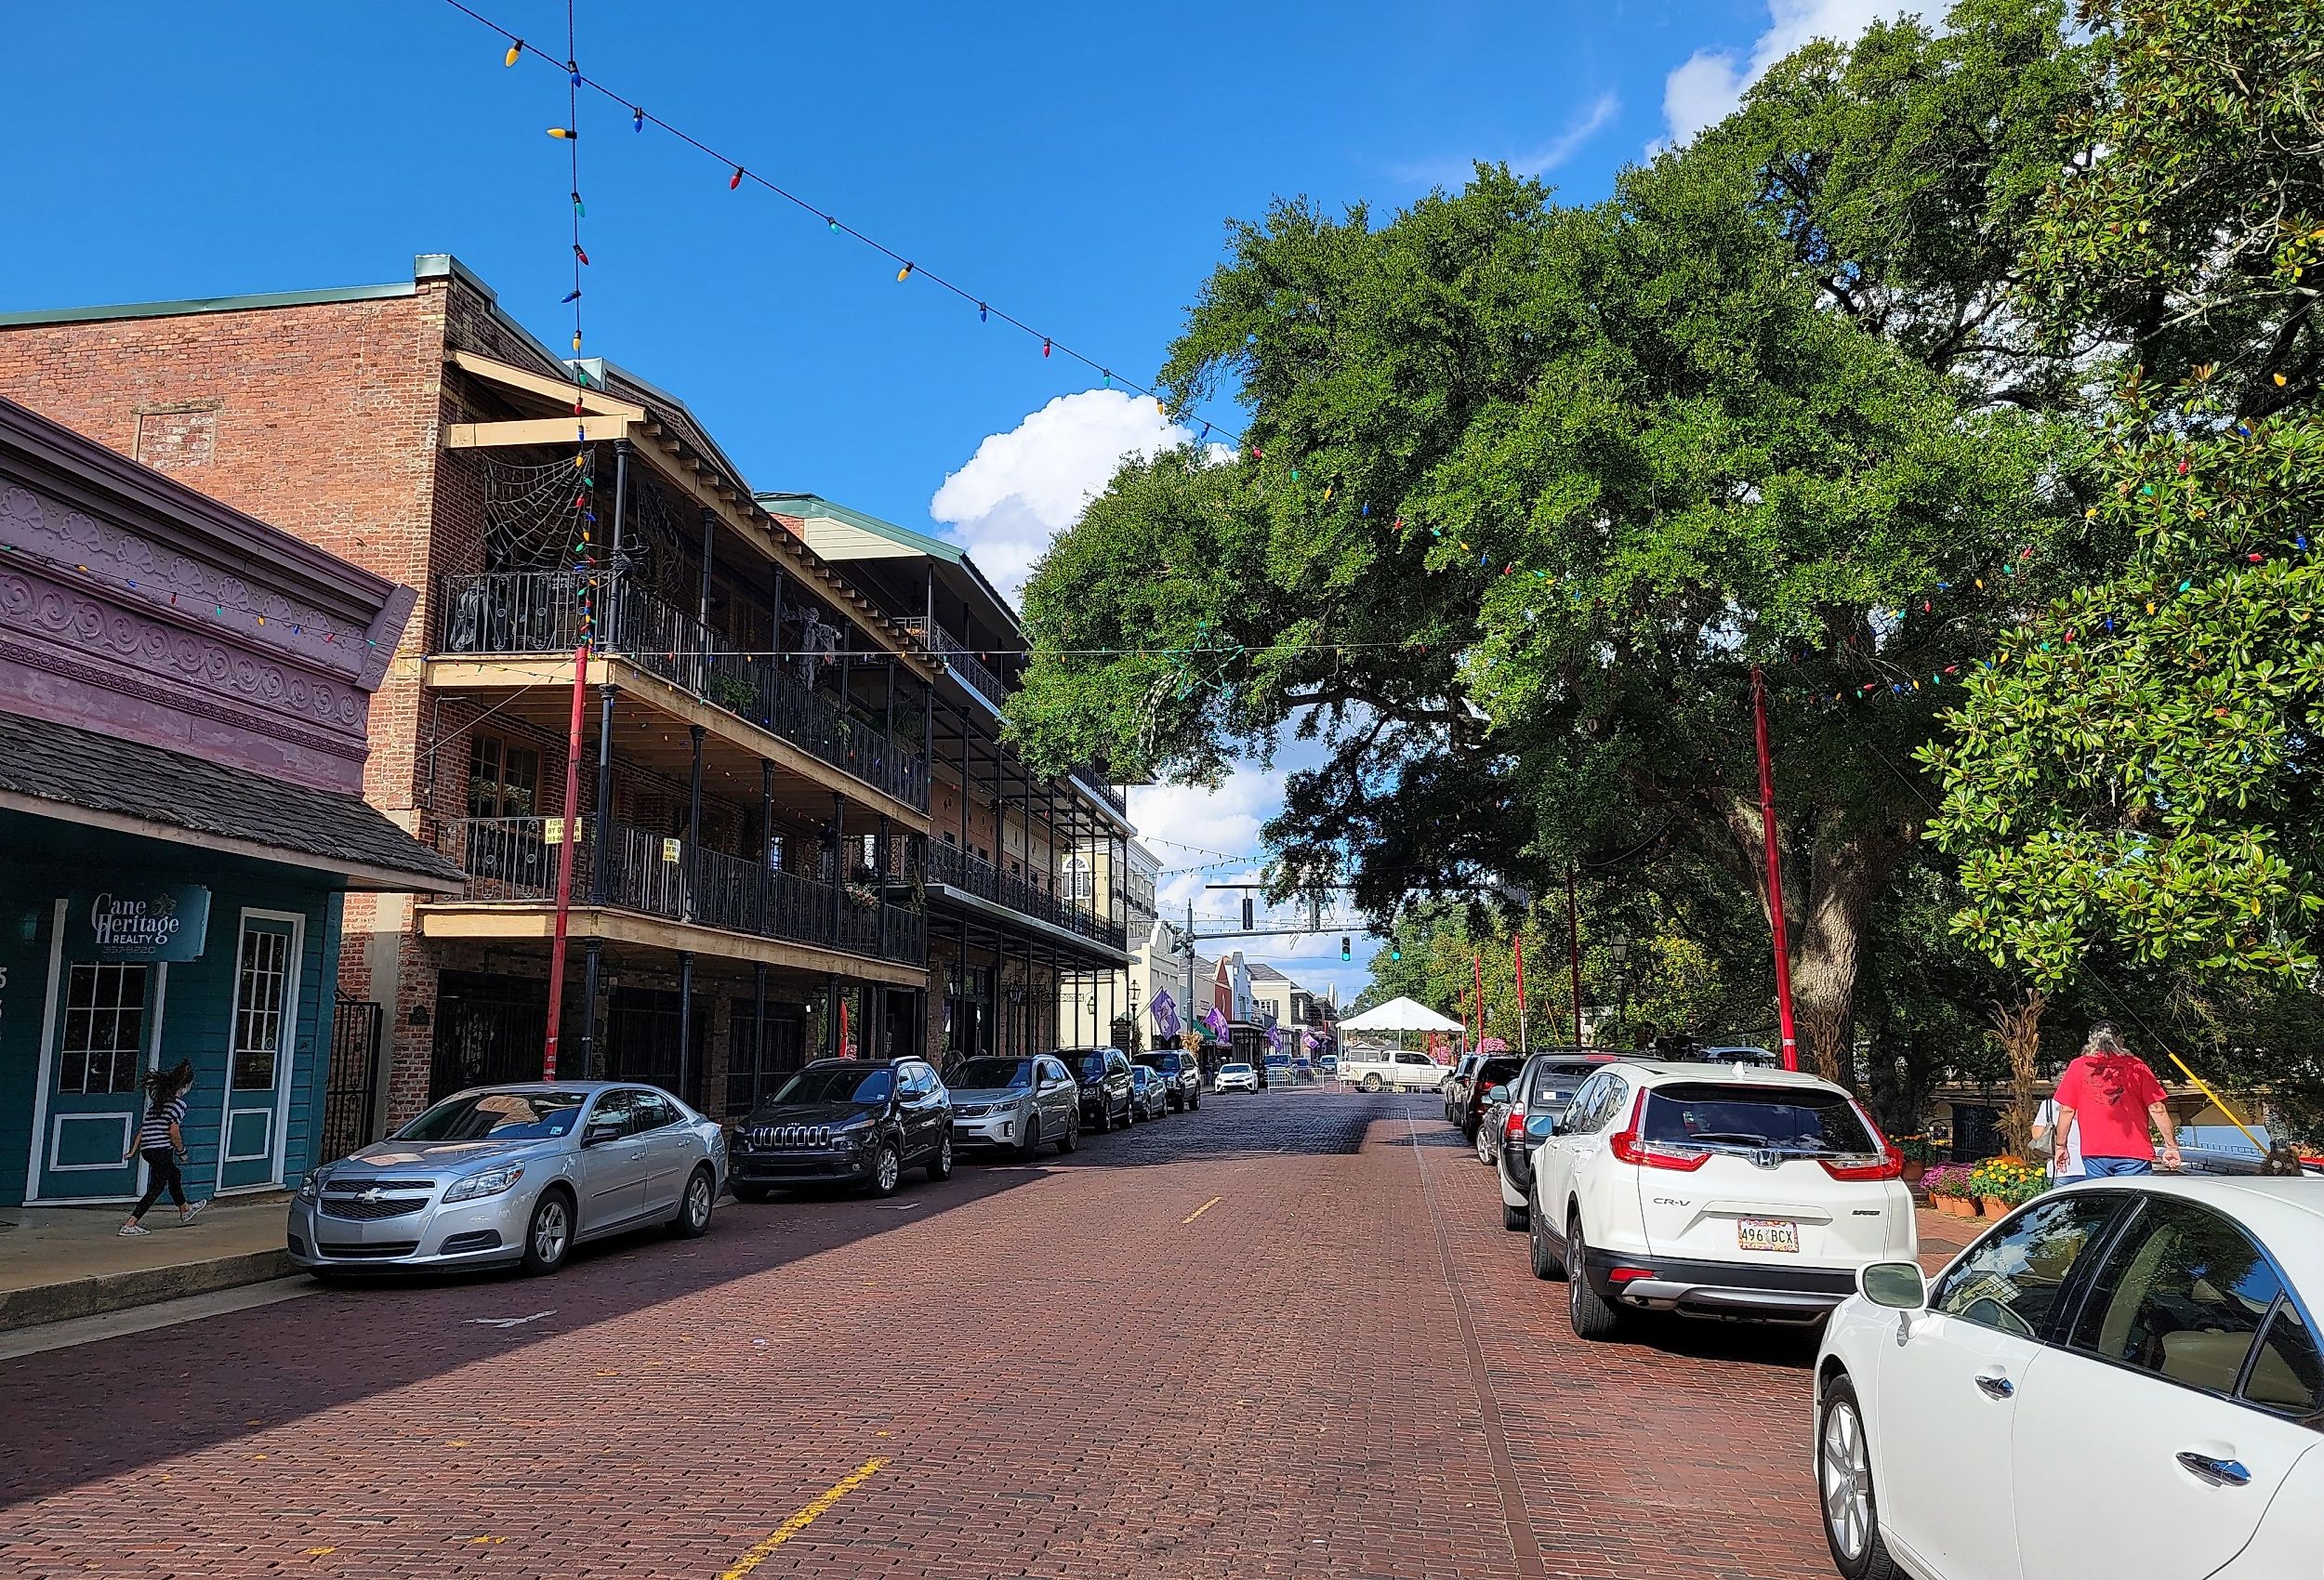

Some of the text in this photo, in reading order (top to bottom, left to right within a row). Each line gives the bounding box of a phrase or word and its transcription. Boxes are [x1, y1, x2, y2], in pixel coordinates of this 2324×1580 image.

[91, 892, 147, 931] Cane
[95, 915, 179, 944] Heritage
[112, 934, 153, 944] REALTY
[1653, 1197, 1691, 1206] CR-V
[1742, 1228, 1793, 1244] 496 BCX
